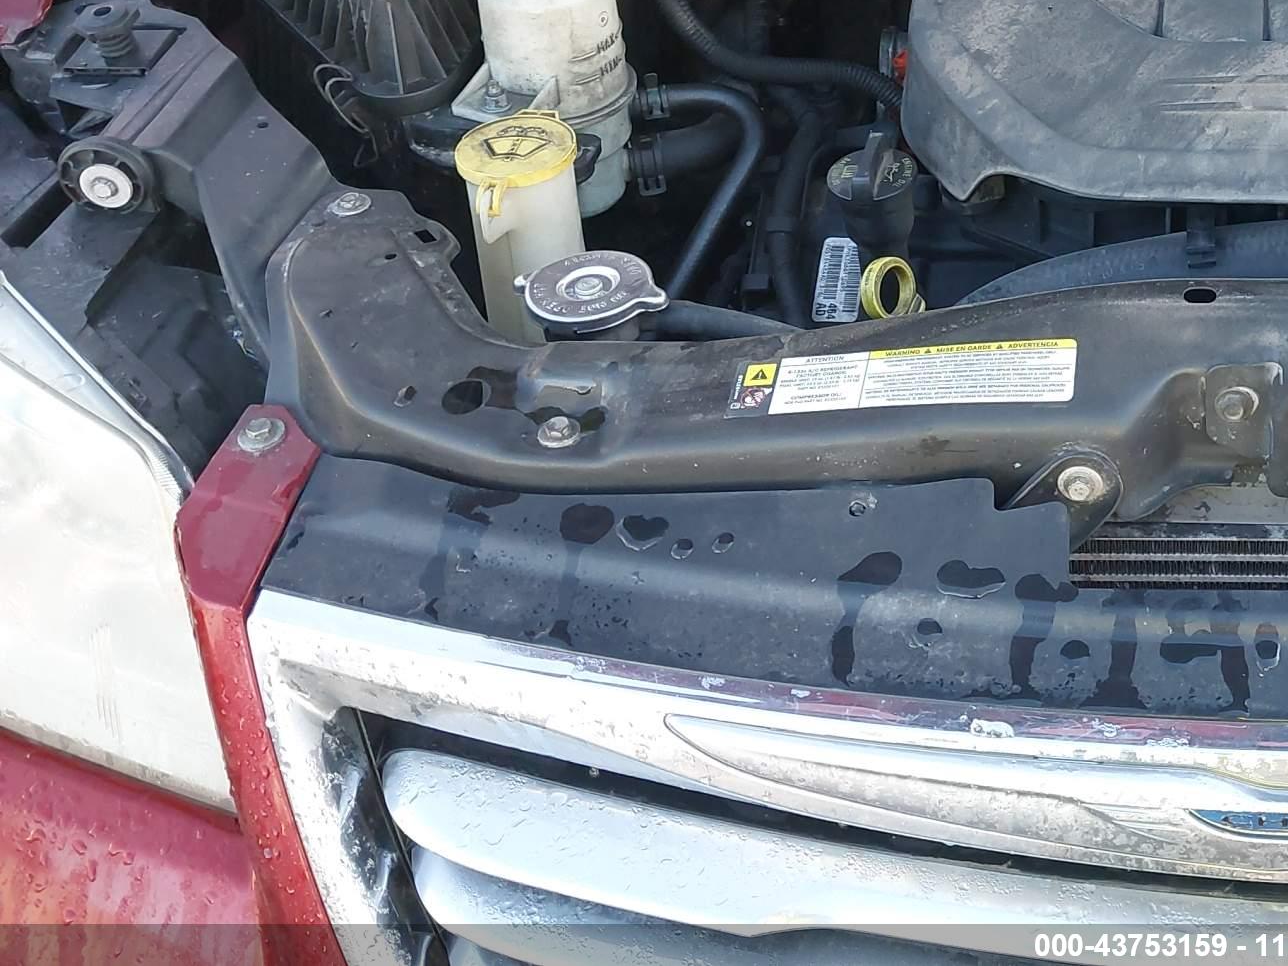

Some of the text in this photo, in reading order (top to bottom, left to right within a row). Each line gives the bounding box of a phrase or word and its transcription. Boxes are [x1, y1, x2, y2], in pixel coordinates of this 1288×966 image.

[885, 348, 920, 357] WARNING
[1007, 341, 1059, 349] ADVERTENCIA
[805, 355, 845, 364] ATTENTION
